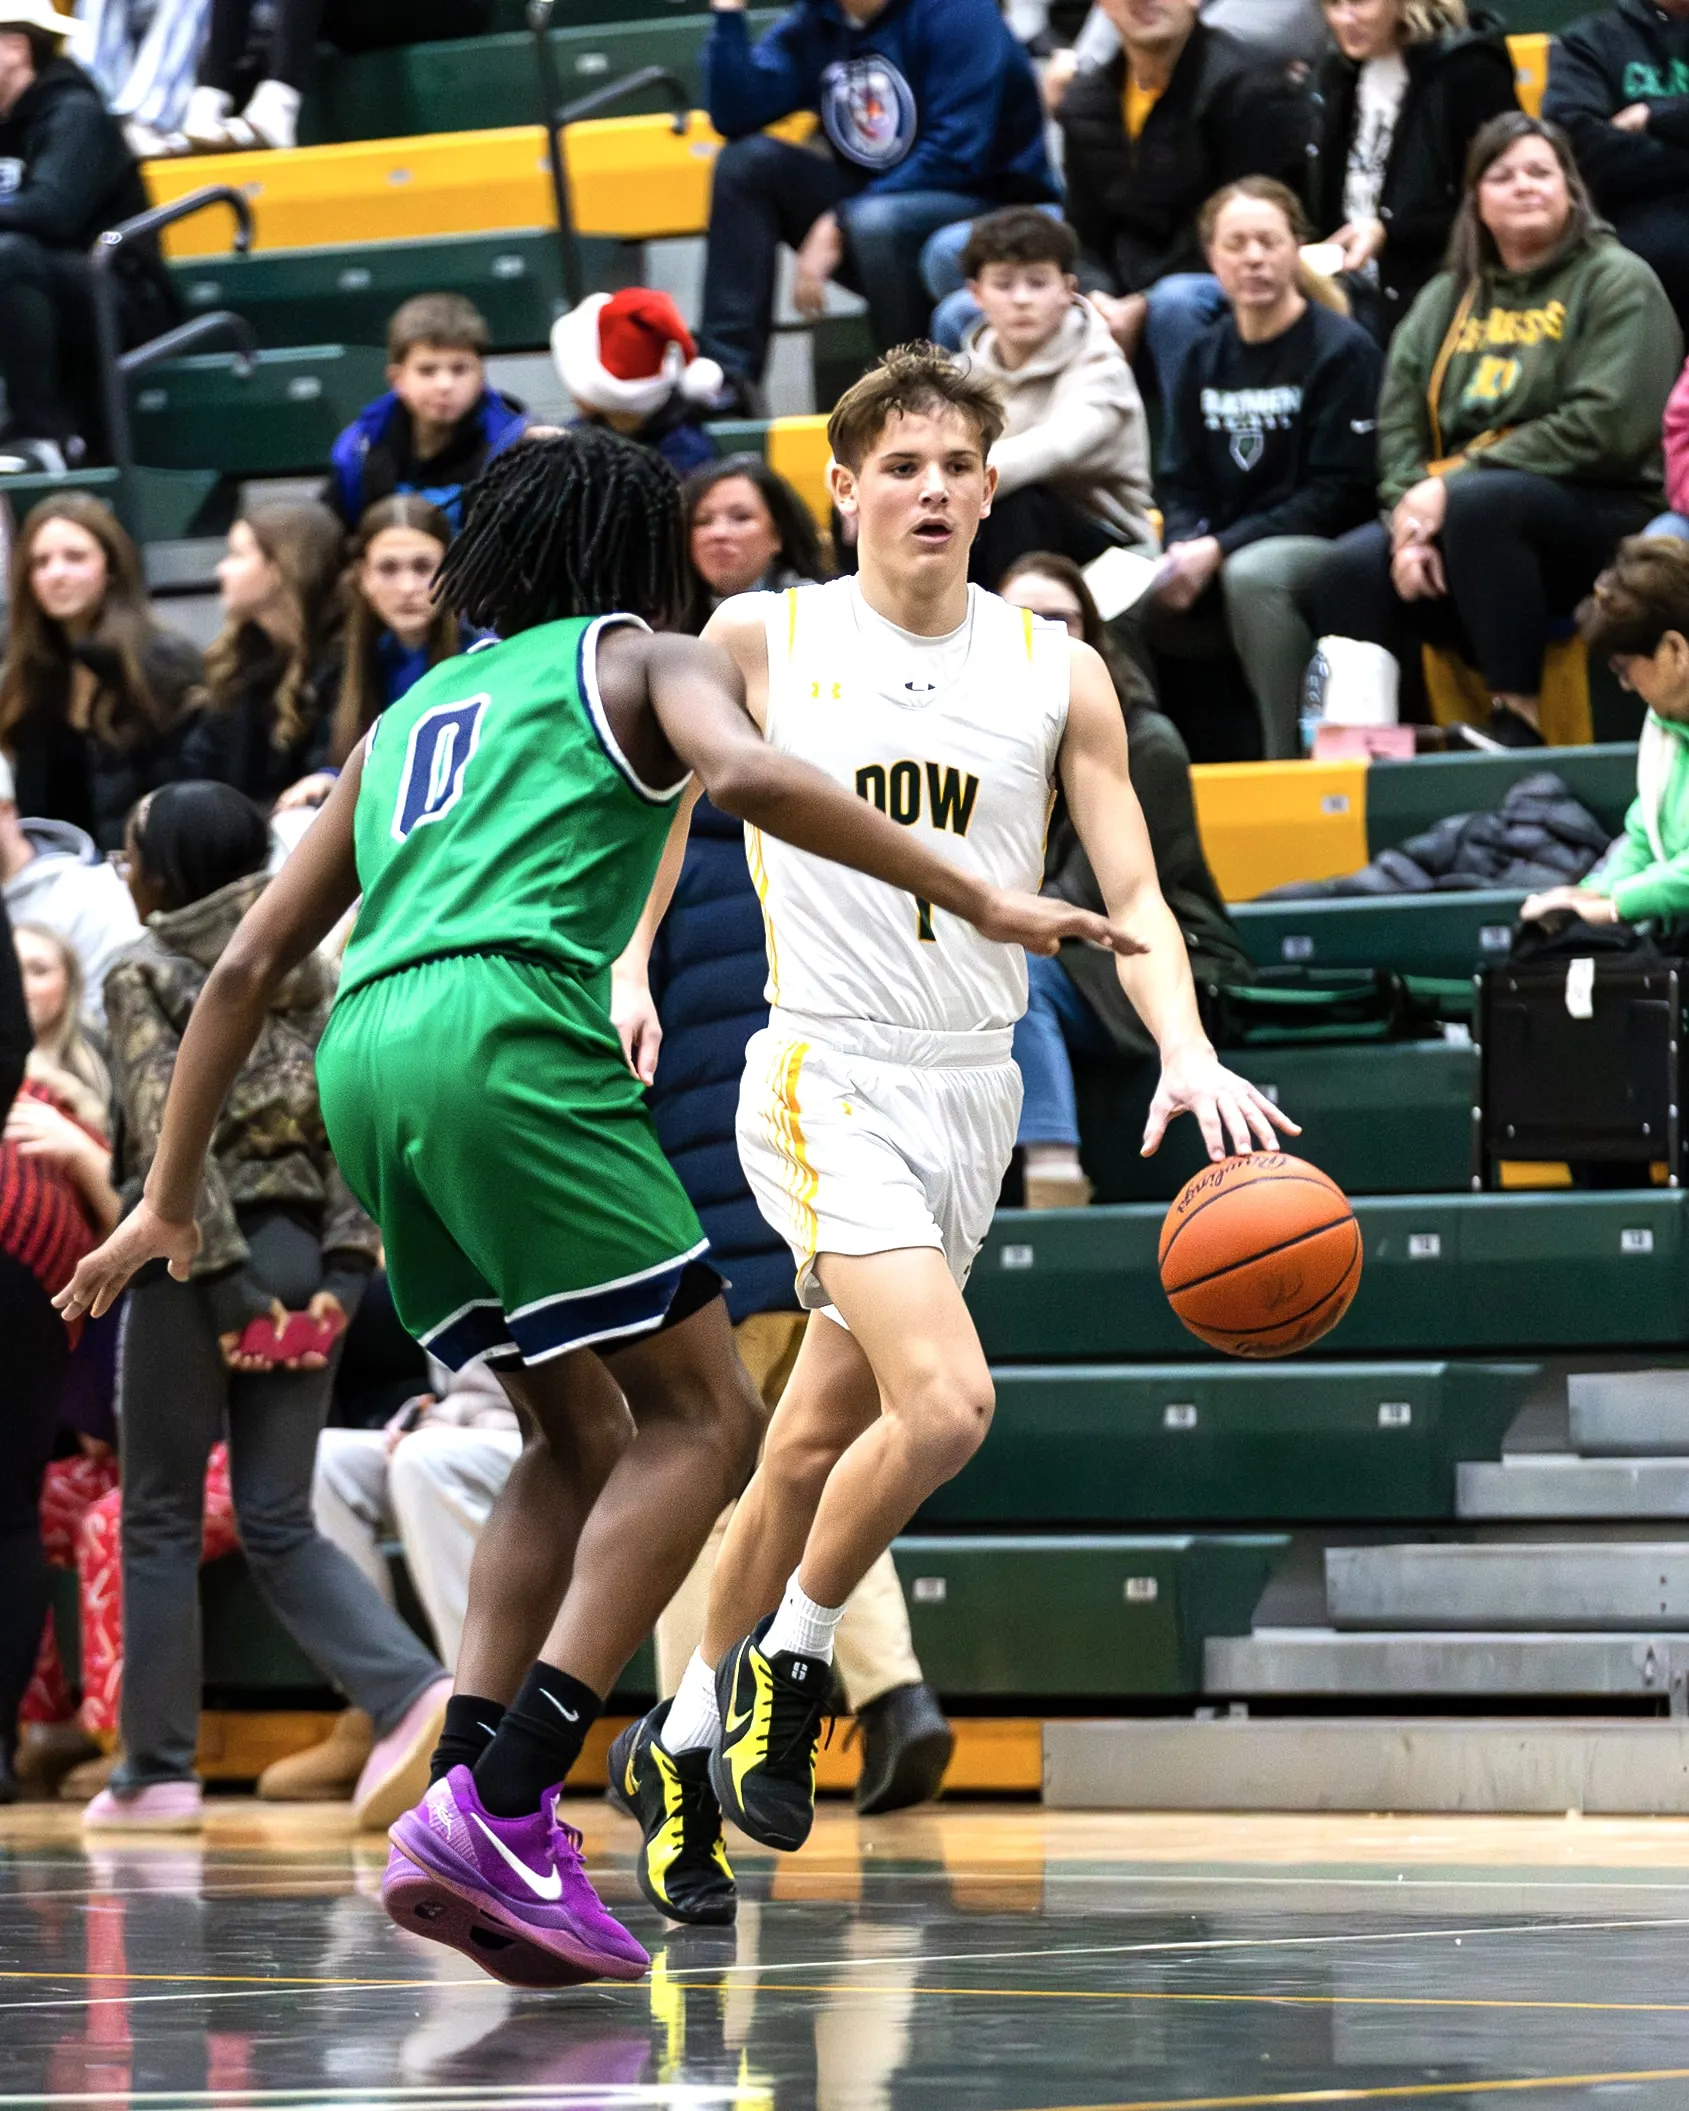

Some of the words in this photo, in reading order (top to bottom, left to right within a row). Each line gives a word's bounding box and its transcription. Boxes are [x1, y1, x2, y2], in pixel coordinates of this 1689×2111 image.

[391, 692, 491, 844] 0
[855, 758, 981, 838] DOW
[1177, 1155, 1288, 1213] Rawlings
